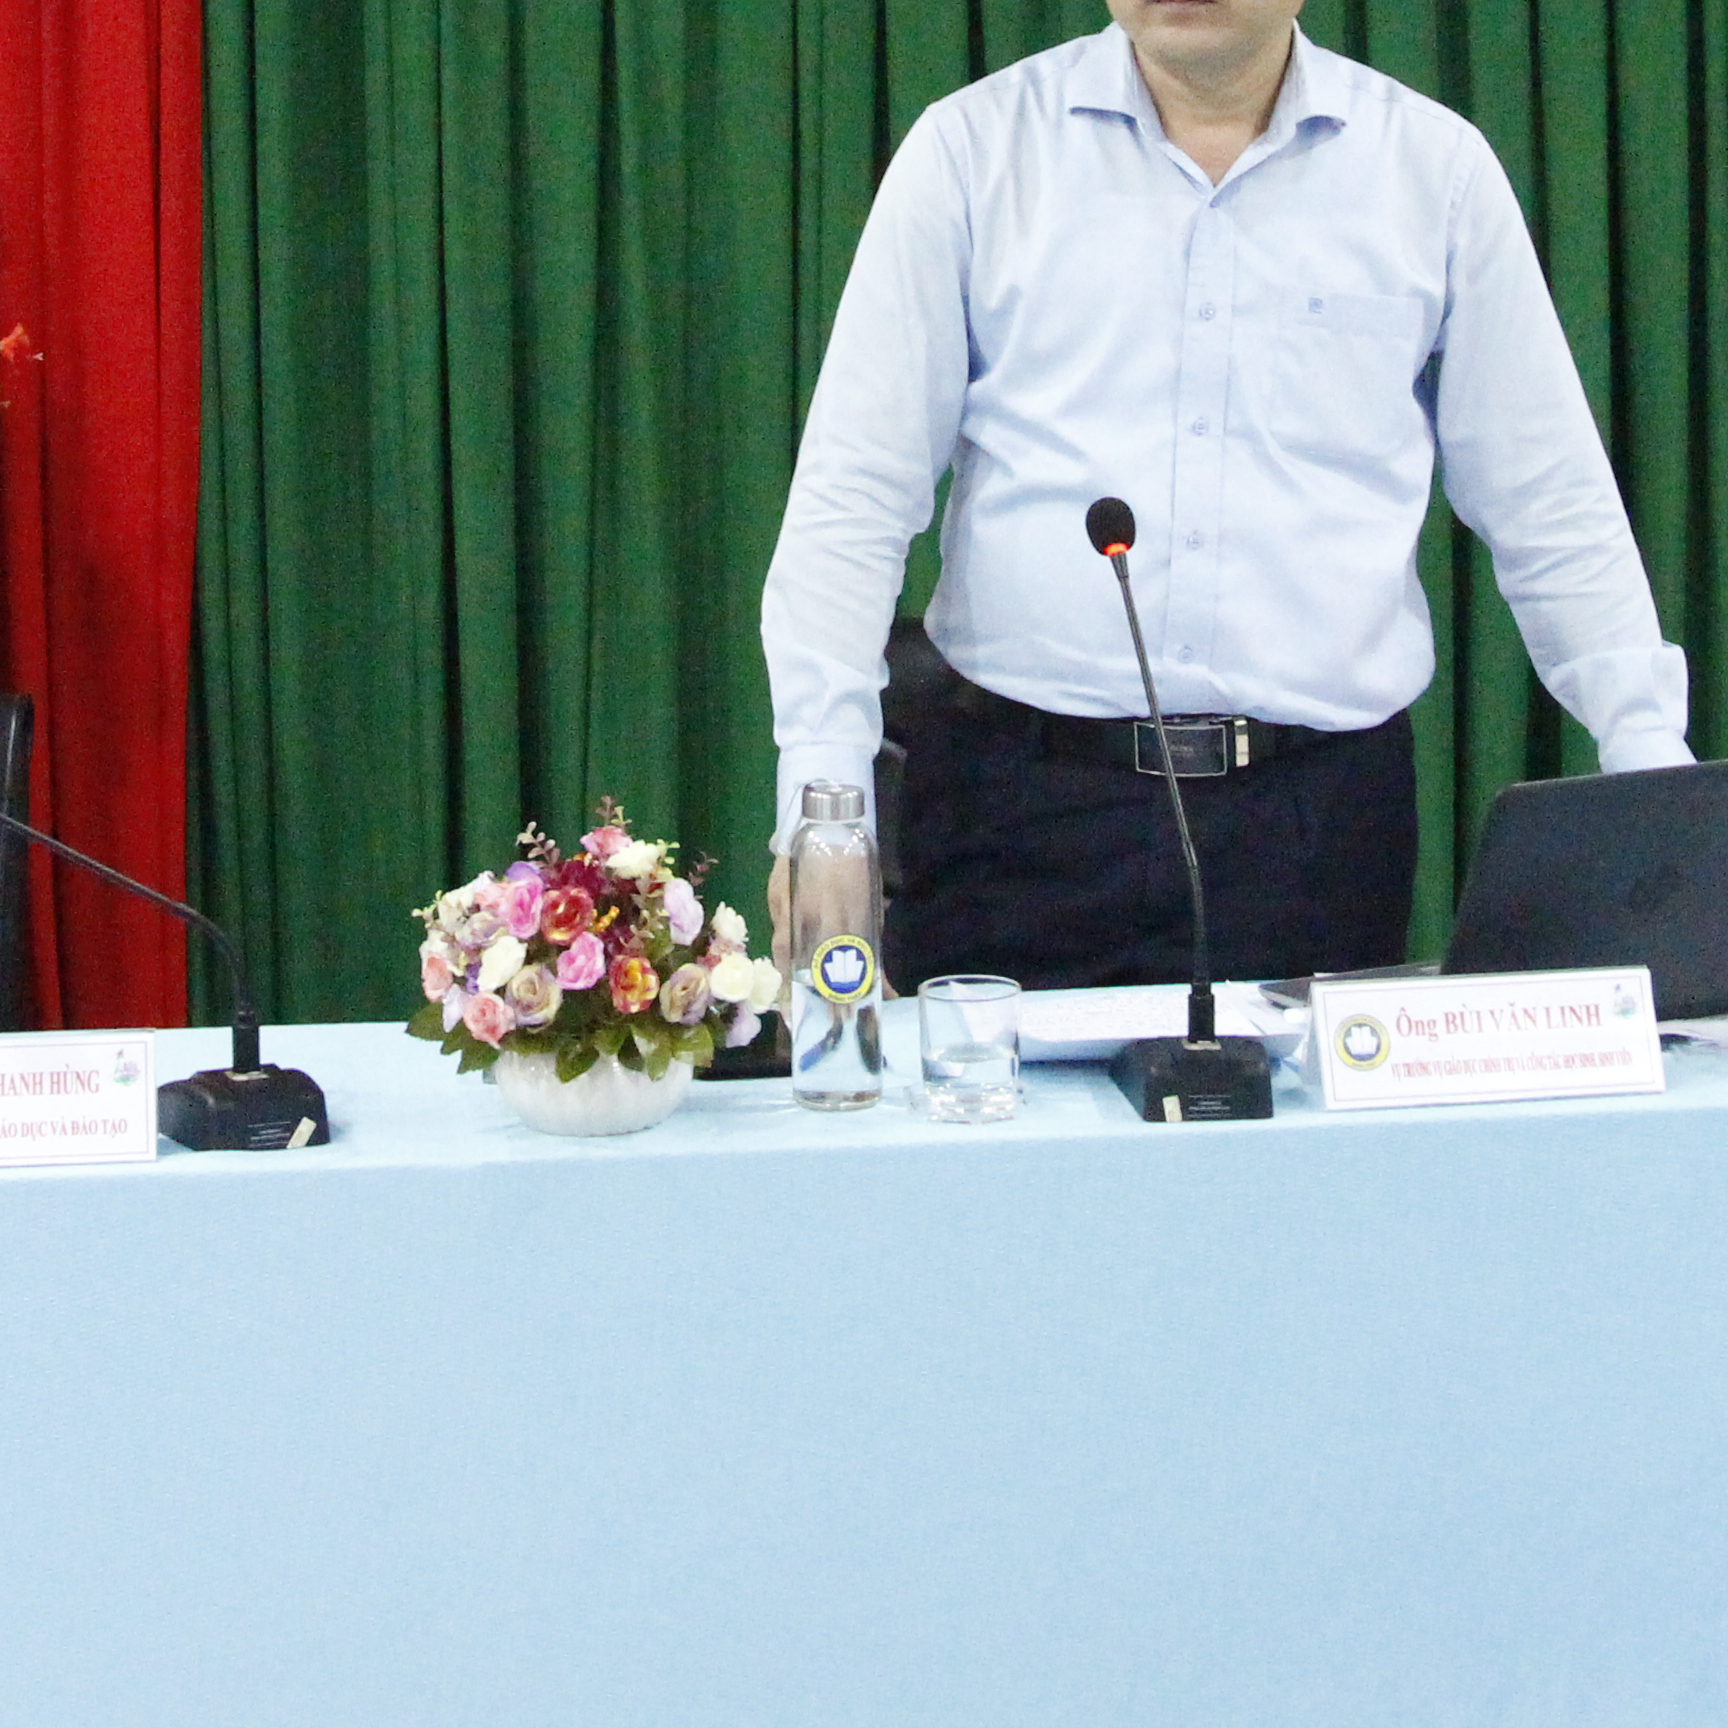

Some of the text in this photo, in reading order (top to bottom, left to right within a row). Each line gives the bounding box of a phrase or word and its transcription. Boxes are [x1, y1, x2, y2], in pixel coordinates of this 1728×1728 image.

[1395, 1001, 1602, 1042] Ông BÙI VĂN LINH
[49, 1064, 101, 1095] HÙNG
